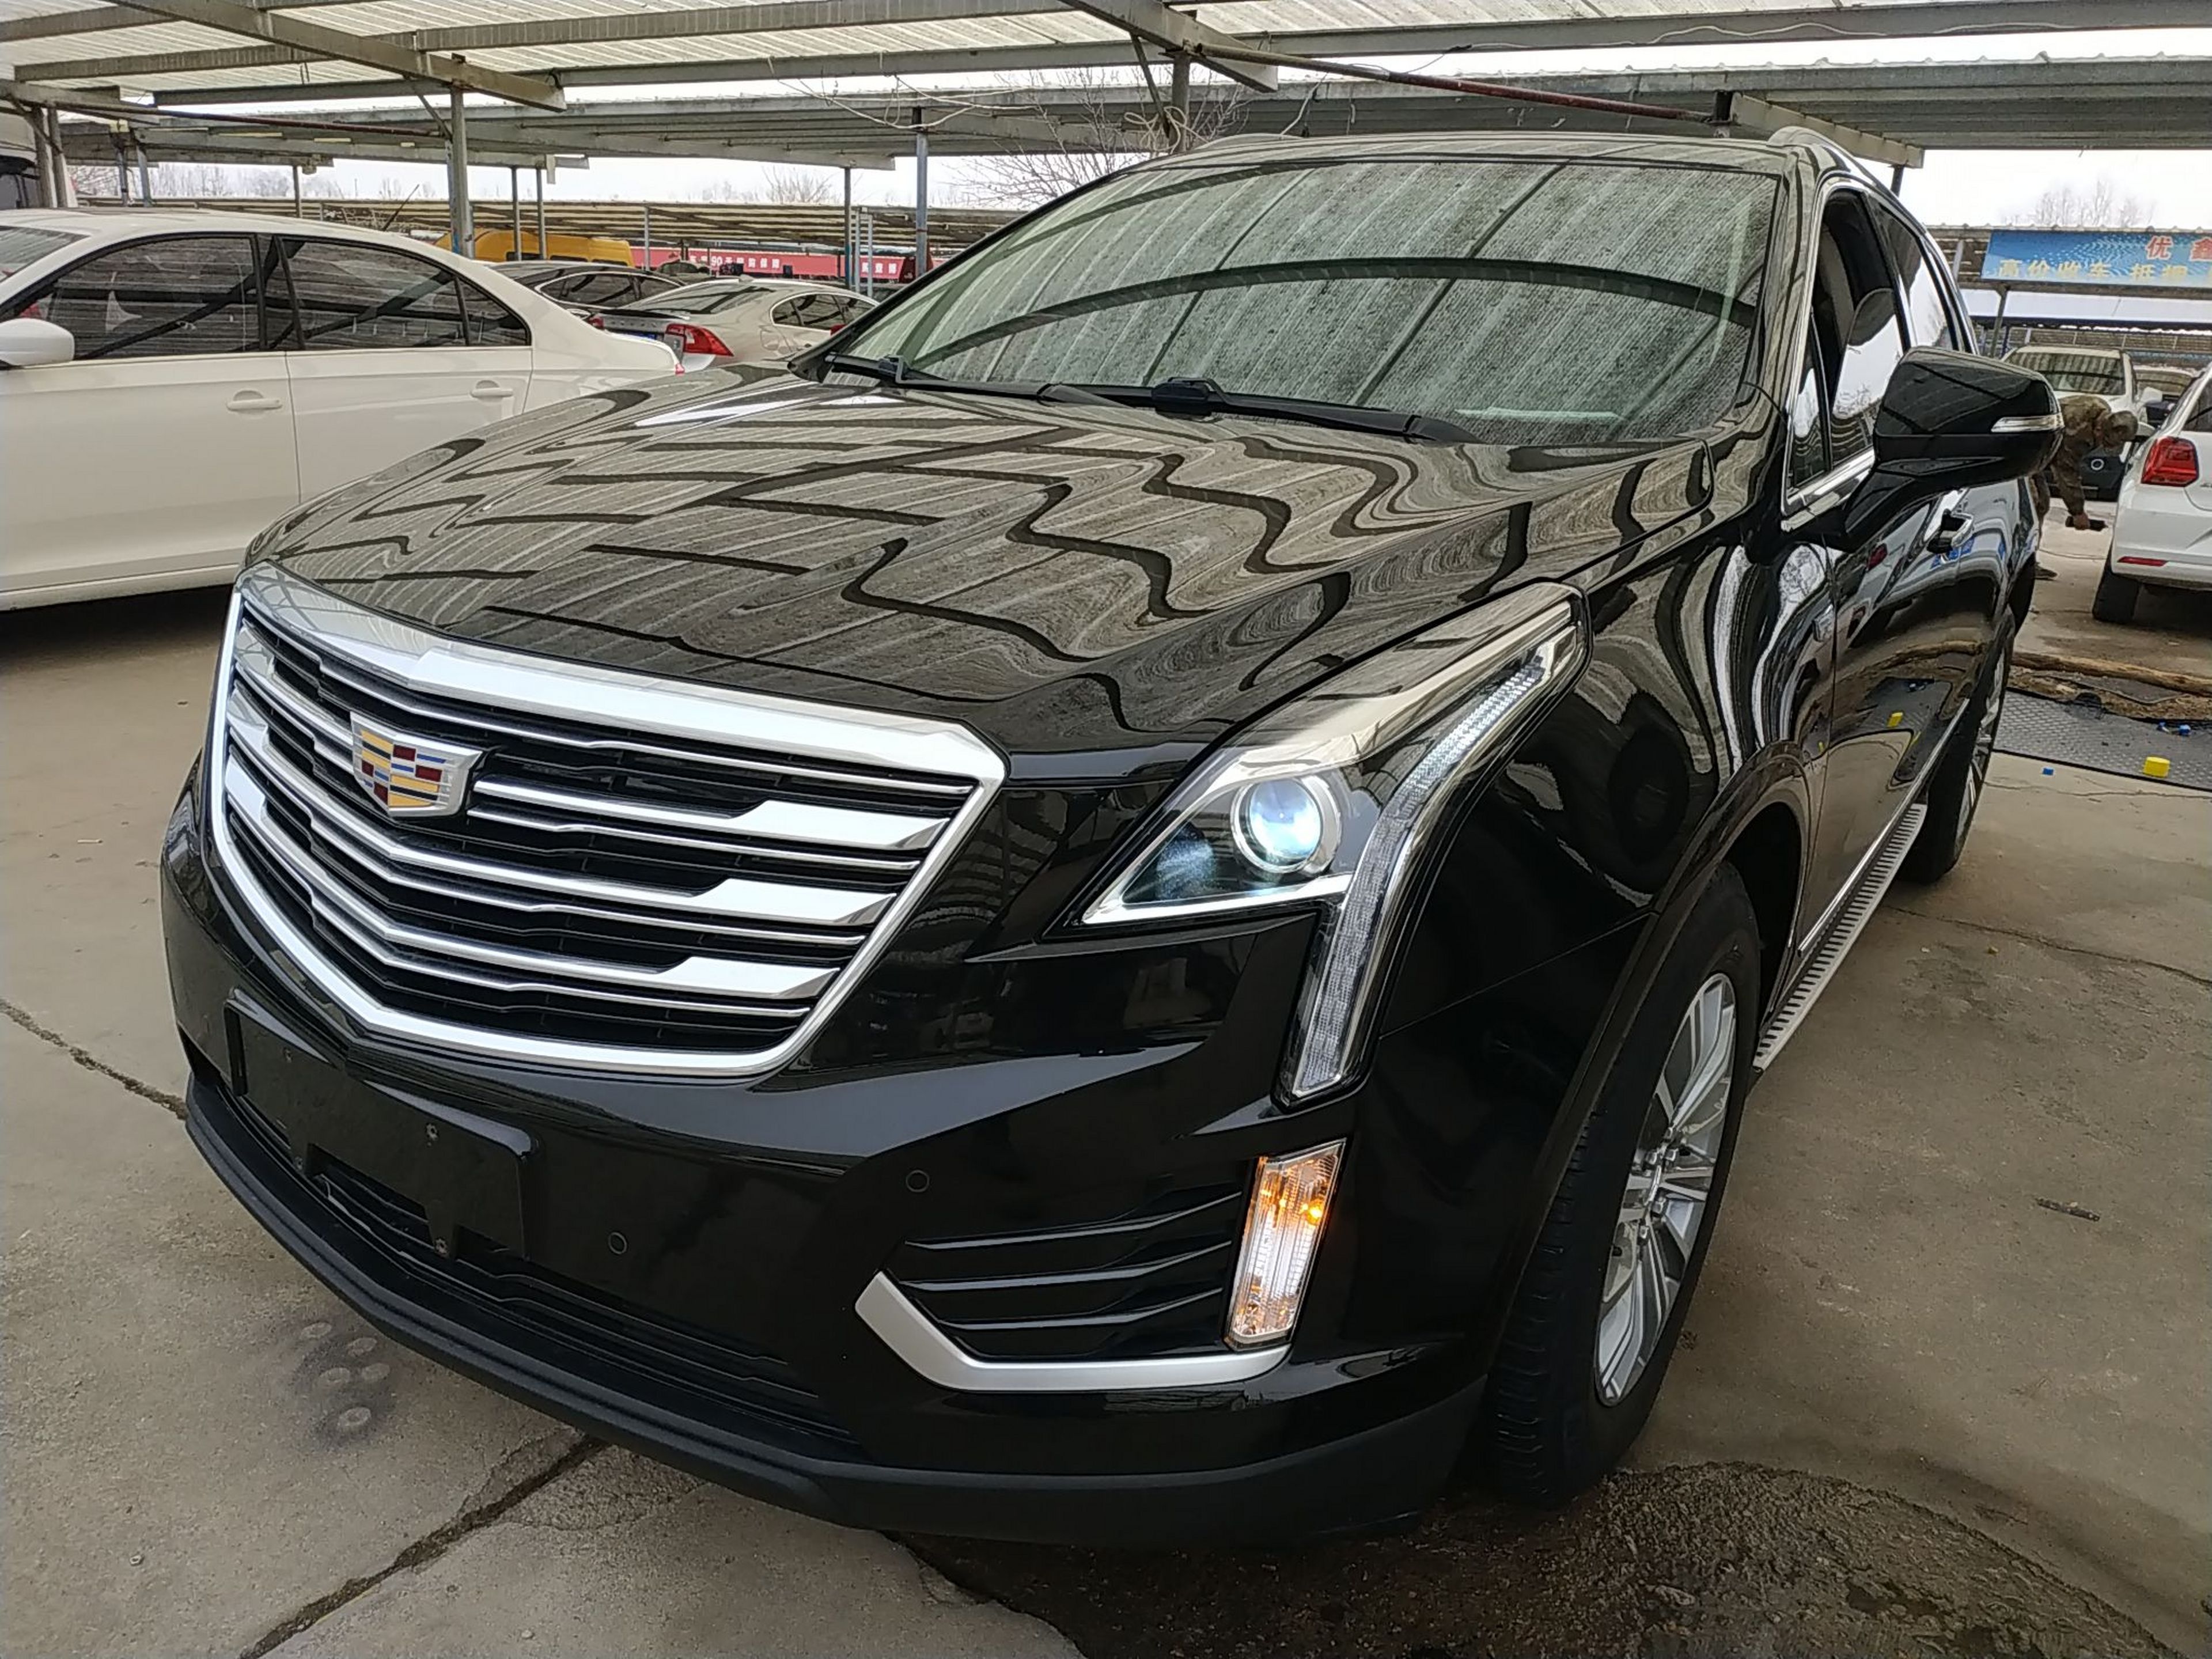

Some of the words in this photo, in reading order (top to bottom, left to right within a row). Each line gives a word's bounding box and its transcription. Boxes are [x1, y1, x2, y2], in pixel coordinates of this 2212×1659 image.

[2146, 235, 2212, 262] 优鑫
[1998, 259, 2112, 278] 高价收车
